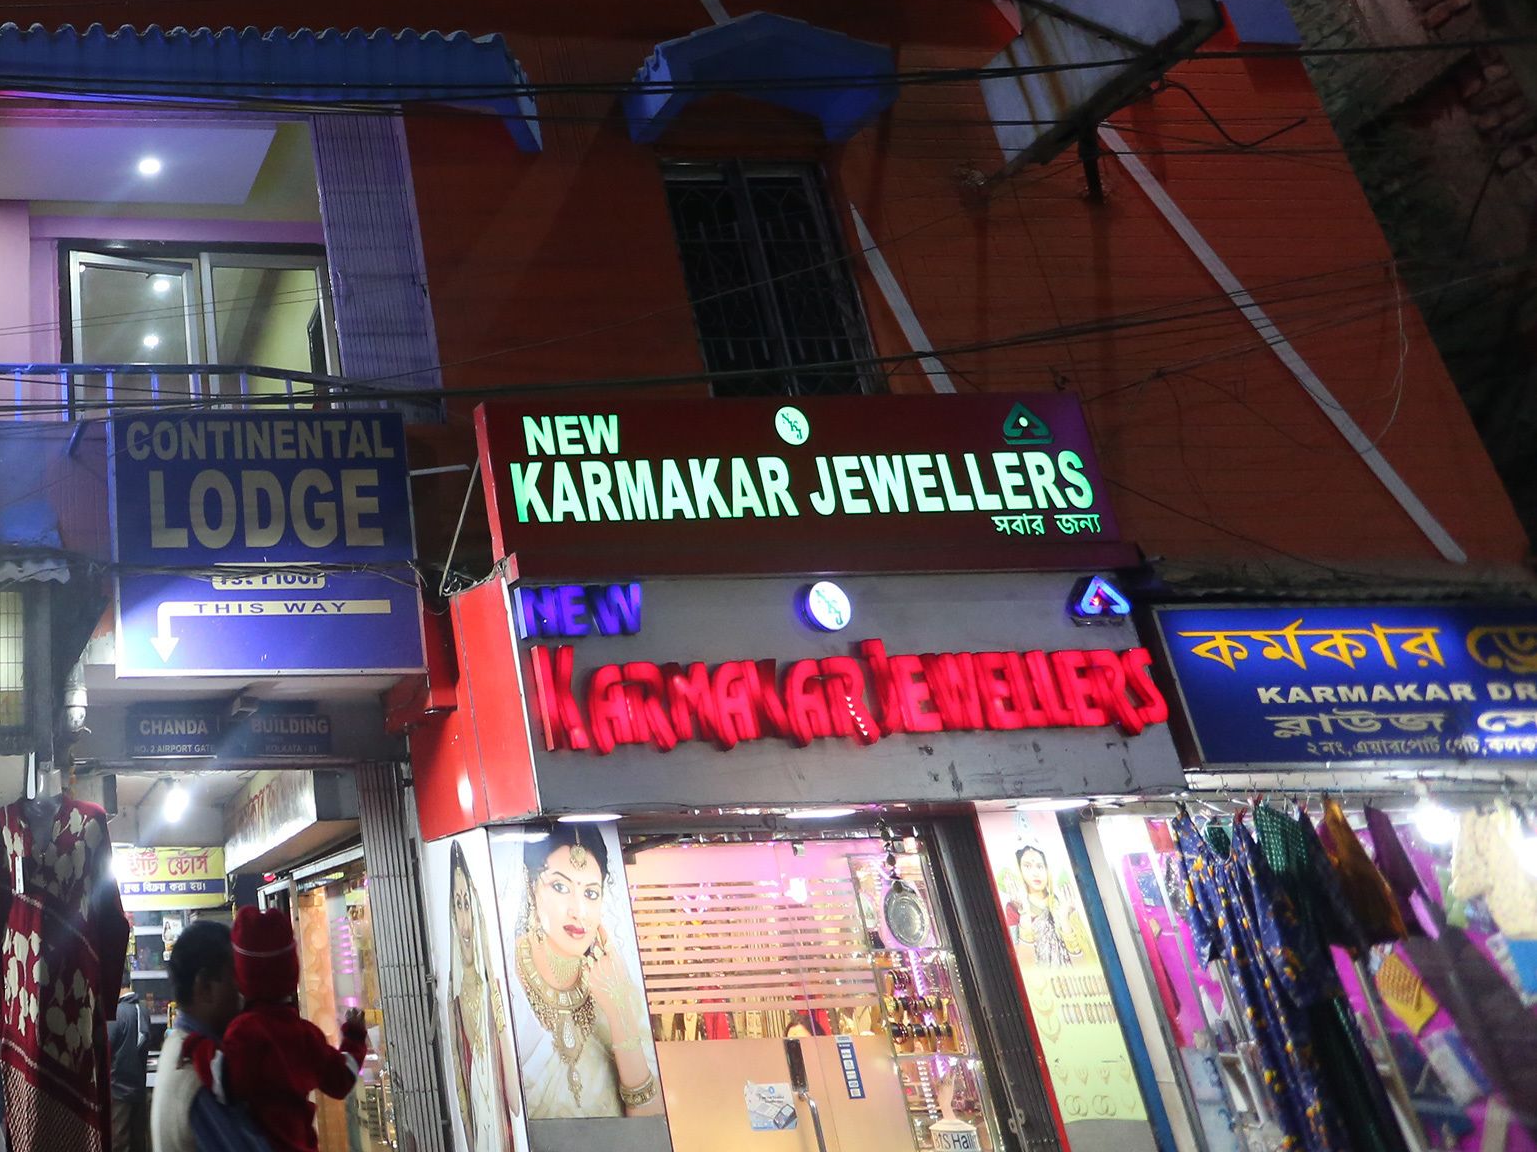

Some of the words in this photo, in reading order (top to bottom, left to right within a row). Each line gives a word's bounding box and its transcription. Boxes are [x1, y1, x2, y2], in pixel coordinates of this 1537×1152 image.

[126, 419, 395, 460] CONTINENTAL
[523, 414, 619, 455] NEW
[509, 456, 800, 524] KARMAKAR
[809, 450, 1095, 517] JEWELLERS
[149, 469, 385, 549] LODGE
[991, 512, 1045, 536] সবার
[1054, 513, 1102, 535] জন্য
[193, 603, 265, 615] THIS
[283, 602, 347, 614] WAY
[513, 583, 642, 639] NEW
[1176, 617, 1447, 673] কর্মকার
[530, 644, 879, 754] KARMAKAR
[861, 638, 1169, 737] JEWELLERS
[1256, 682, 1478, 705] KARMAKAR
[139, 719, 209, 736] CHANDA
[251, 717, 329, 735] BUILDING
